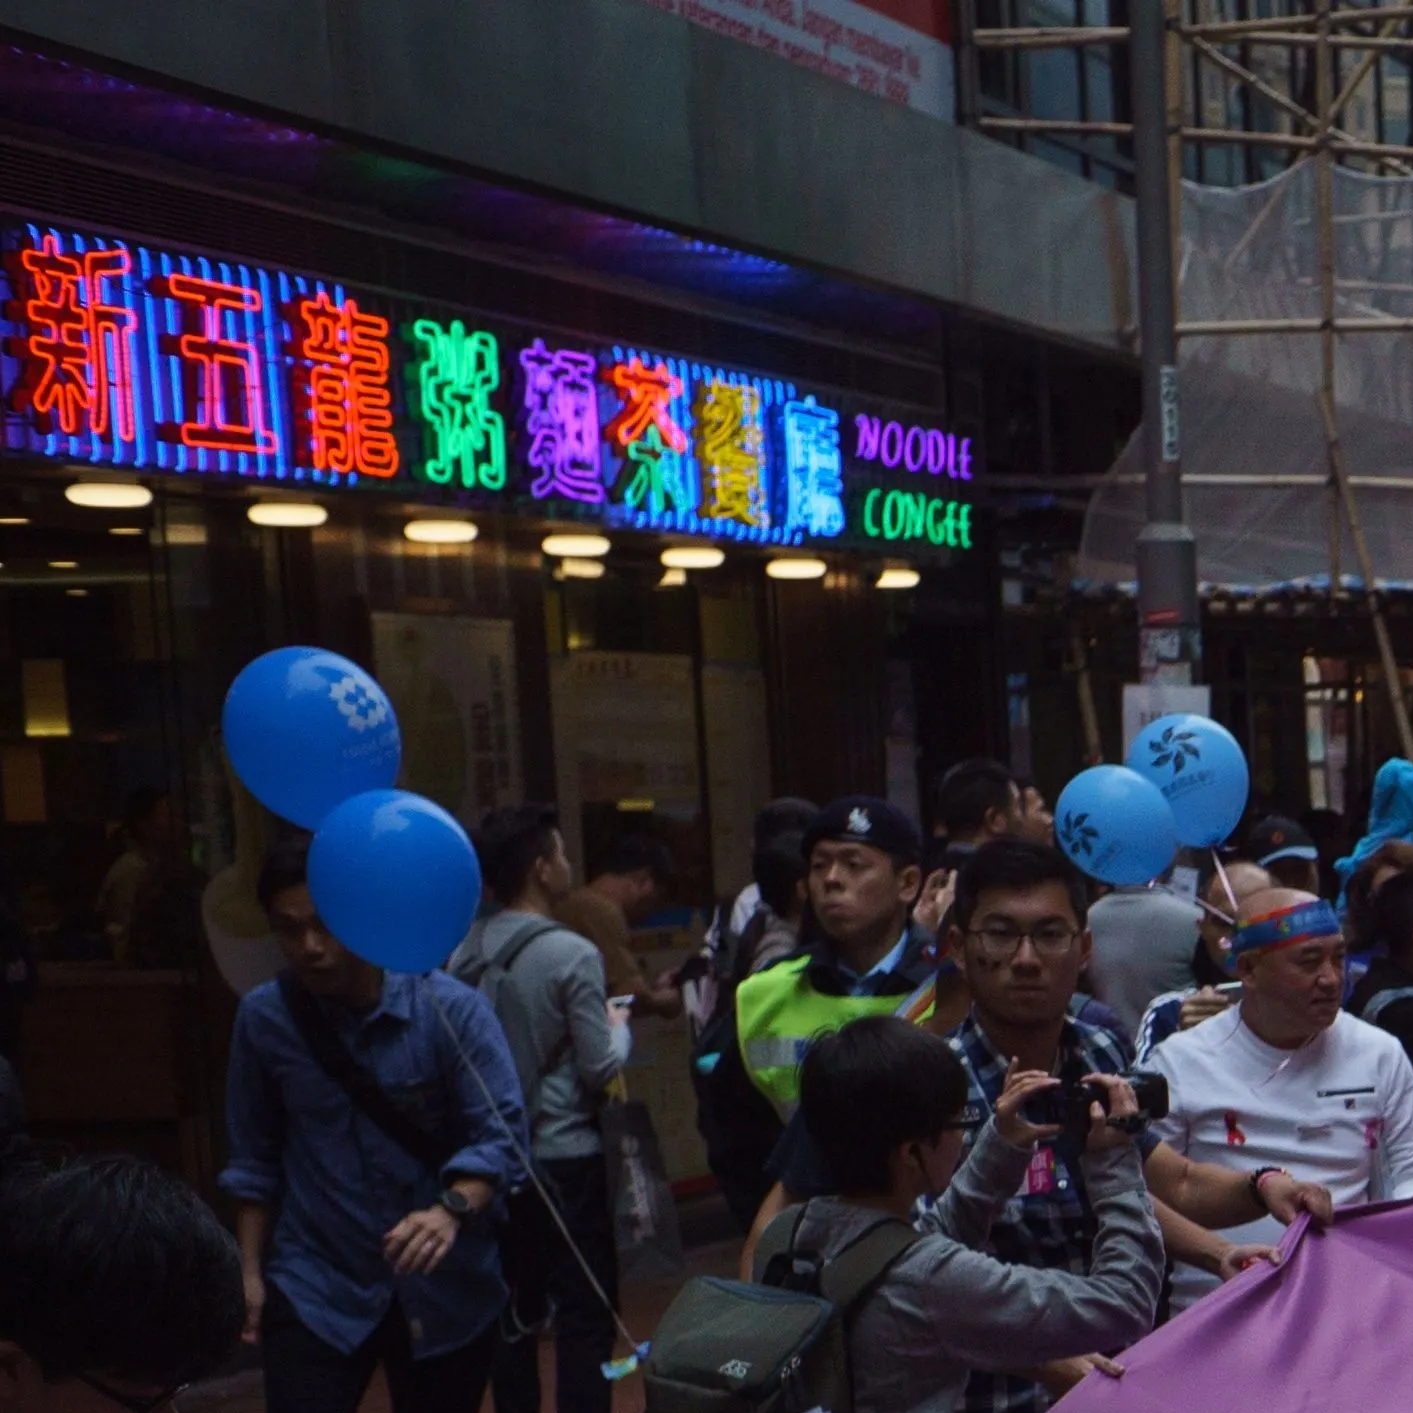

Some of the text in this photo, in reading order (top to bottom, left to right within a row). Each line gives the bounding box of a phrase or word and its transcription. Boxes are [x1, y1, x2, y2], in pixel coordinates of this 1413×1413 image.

[855, 413, 973, 480] NOODLE
[864, 487, 973, 549] CONGEE
[1031, 1149, 1049, 1191] 旗手
